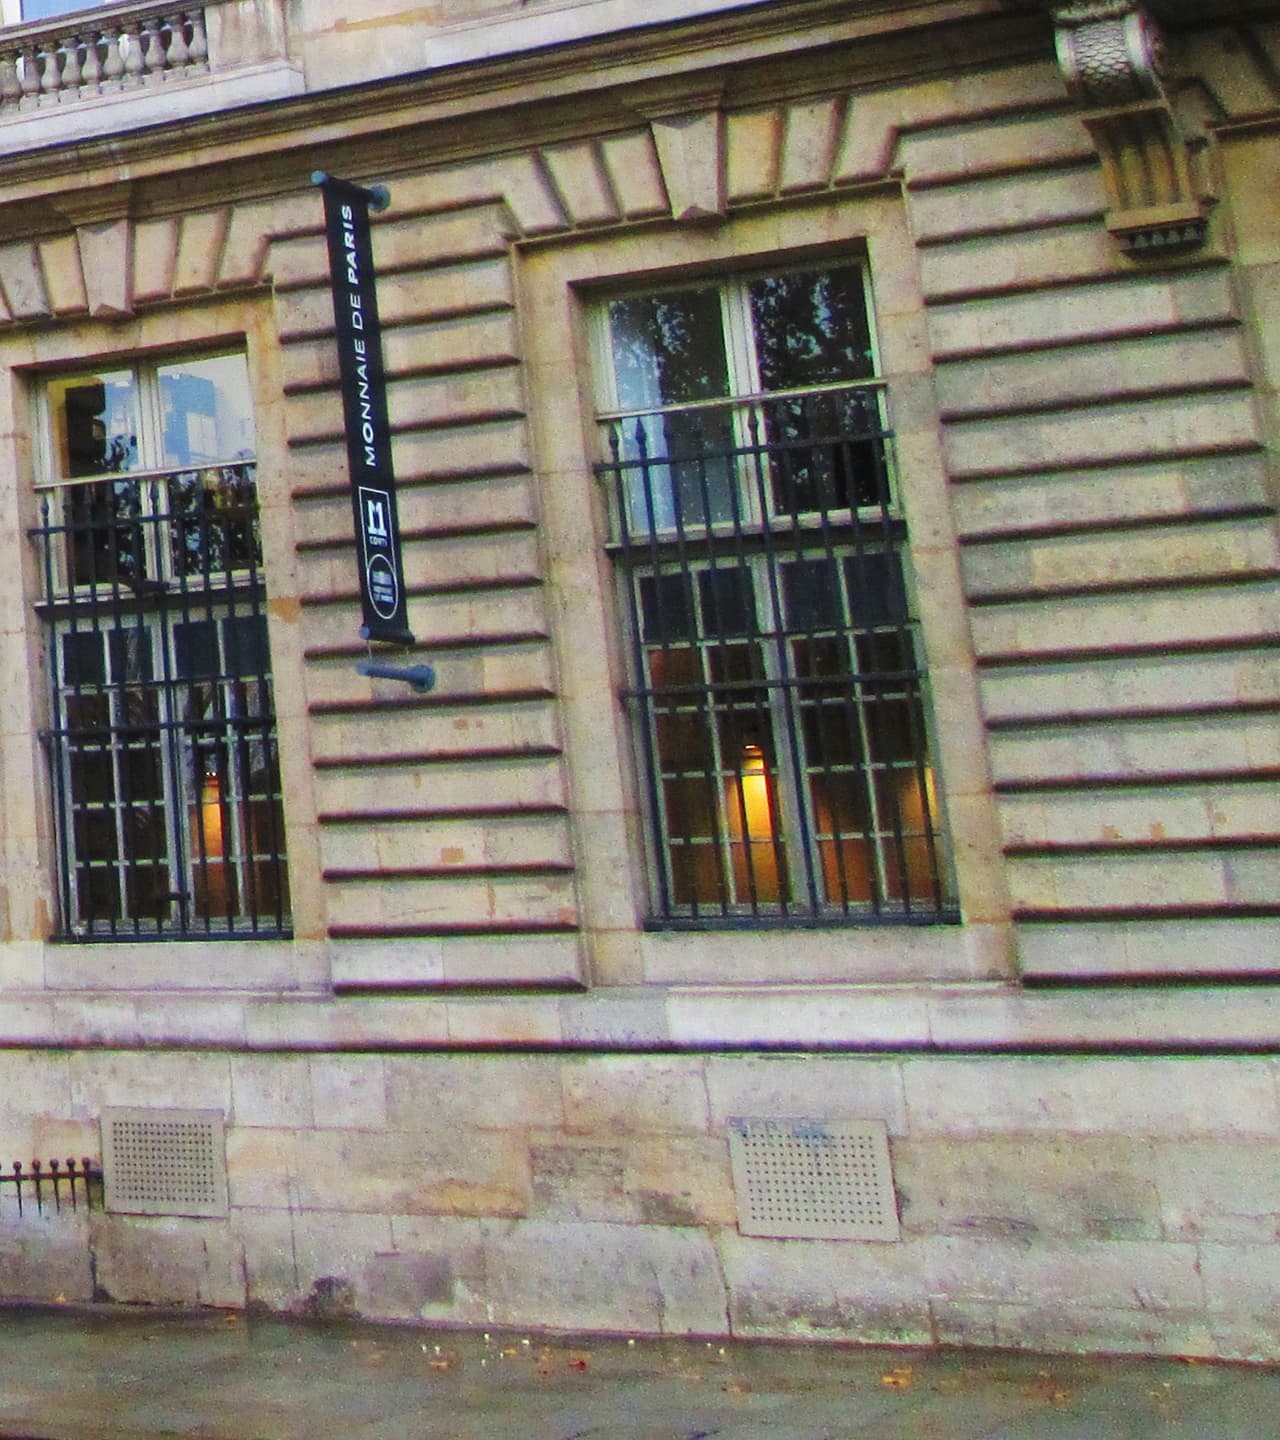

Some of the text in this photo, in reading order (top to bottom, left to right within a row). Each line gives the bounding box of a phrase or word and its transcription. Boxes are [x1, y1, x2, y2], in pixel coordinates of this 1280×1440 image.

[341, 204, 376, 467] MONNAIE DE PARIS
